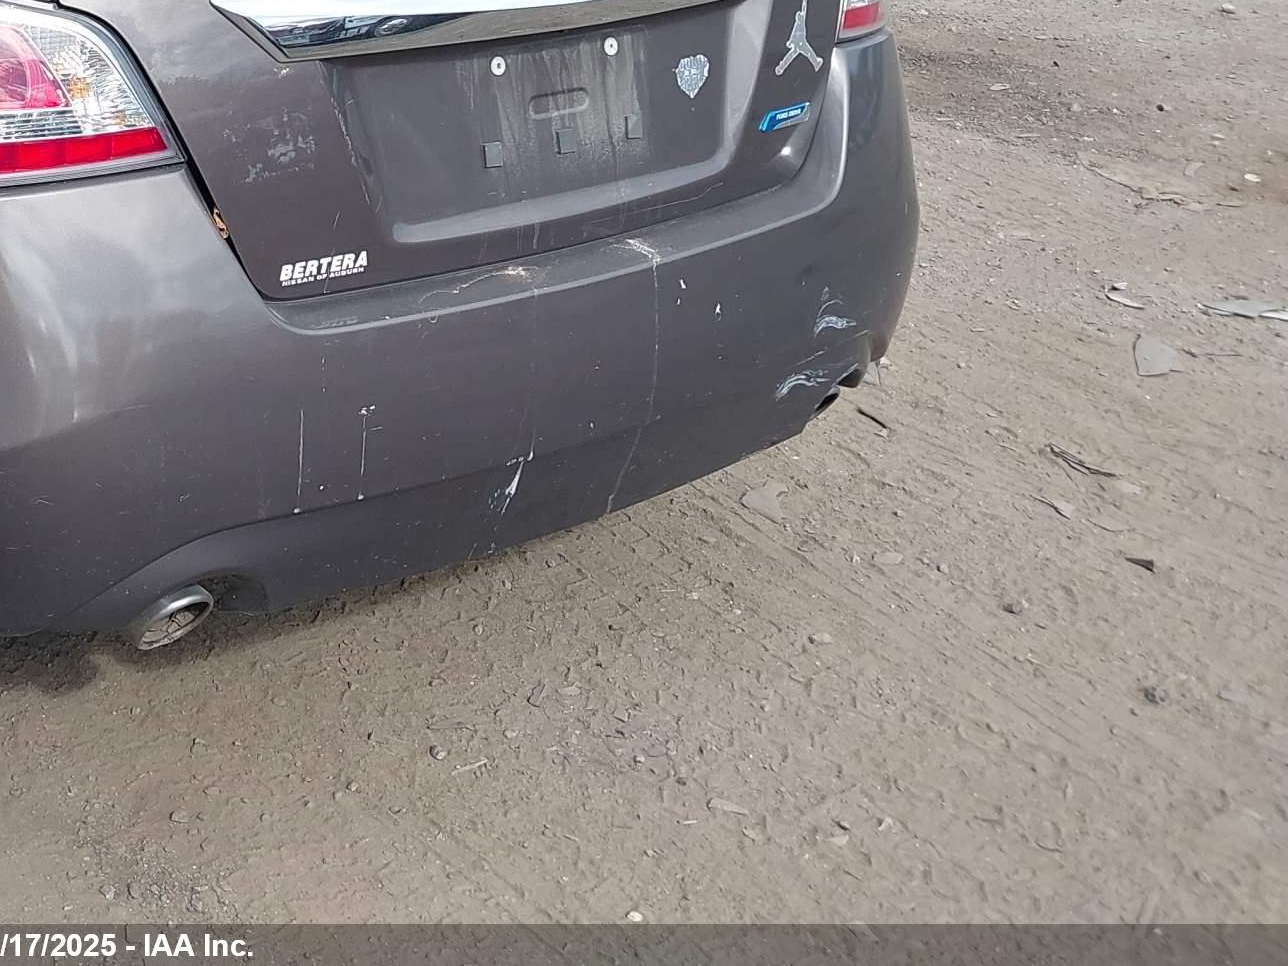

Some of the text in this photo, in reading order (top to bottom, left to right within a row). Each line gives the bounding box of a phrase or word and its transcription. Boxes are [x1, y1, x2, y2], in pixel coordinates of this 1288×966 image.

[279, 250, 368, 282] BERTERA
[281, 276, 314, 286] NISSAN
[329, 267, 364, 278] AUBURN
